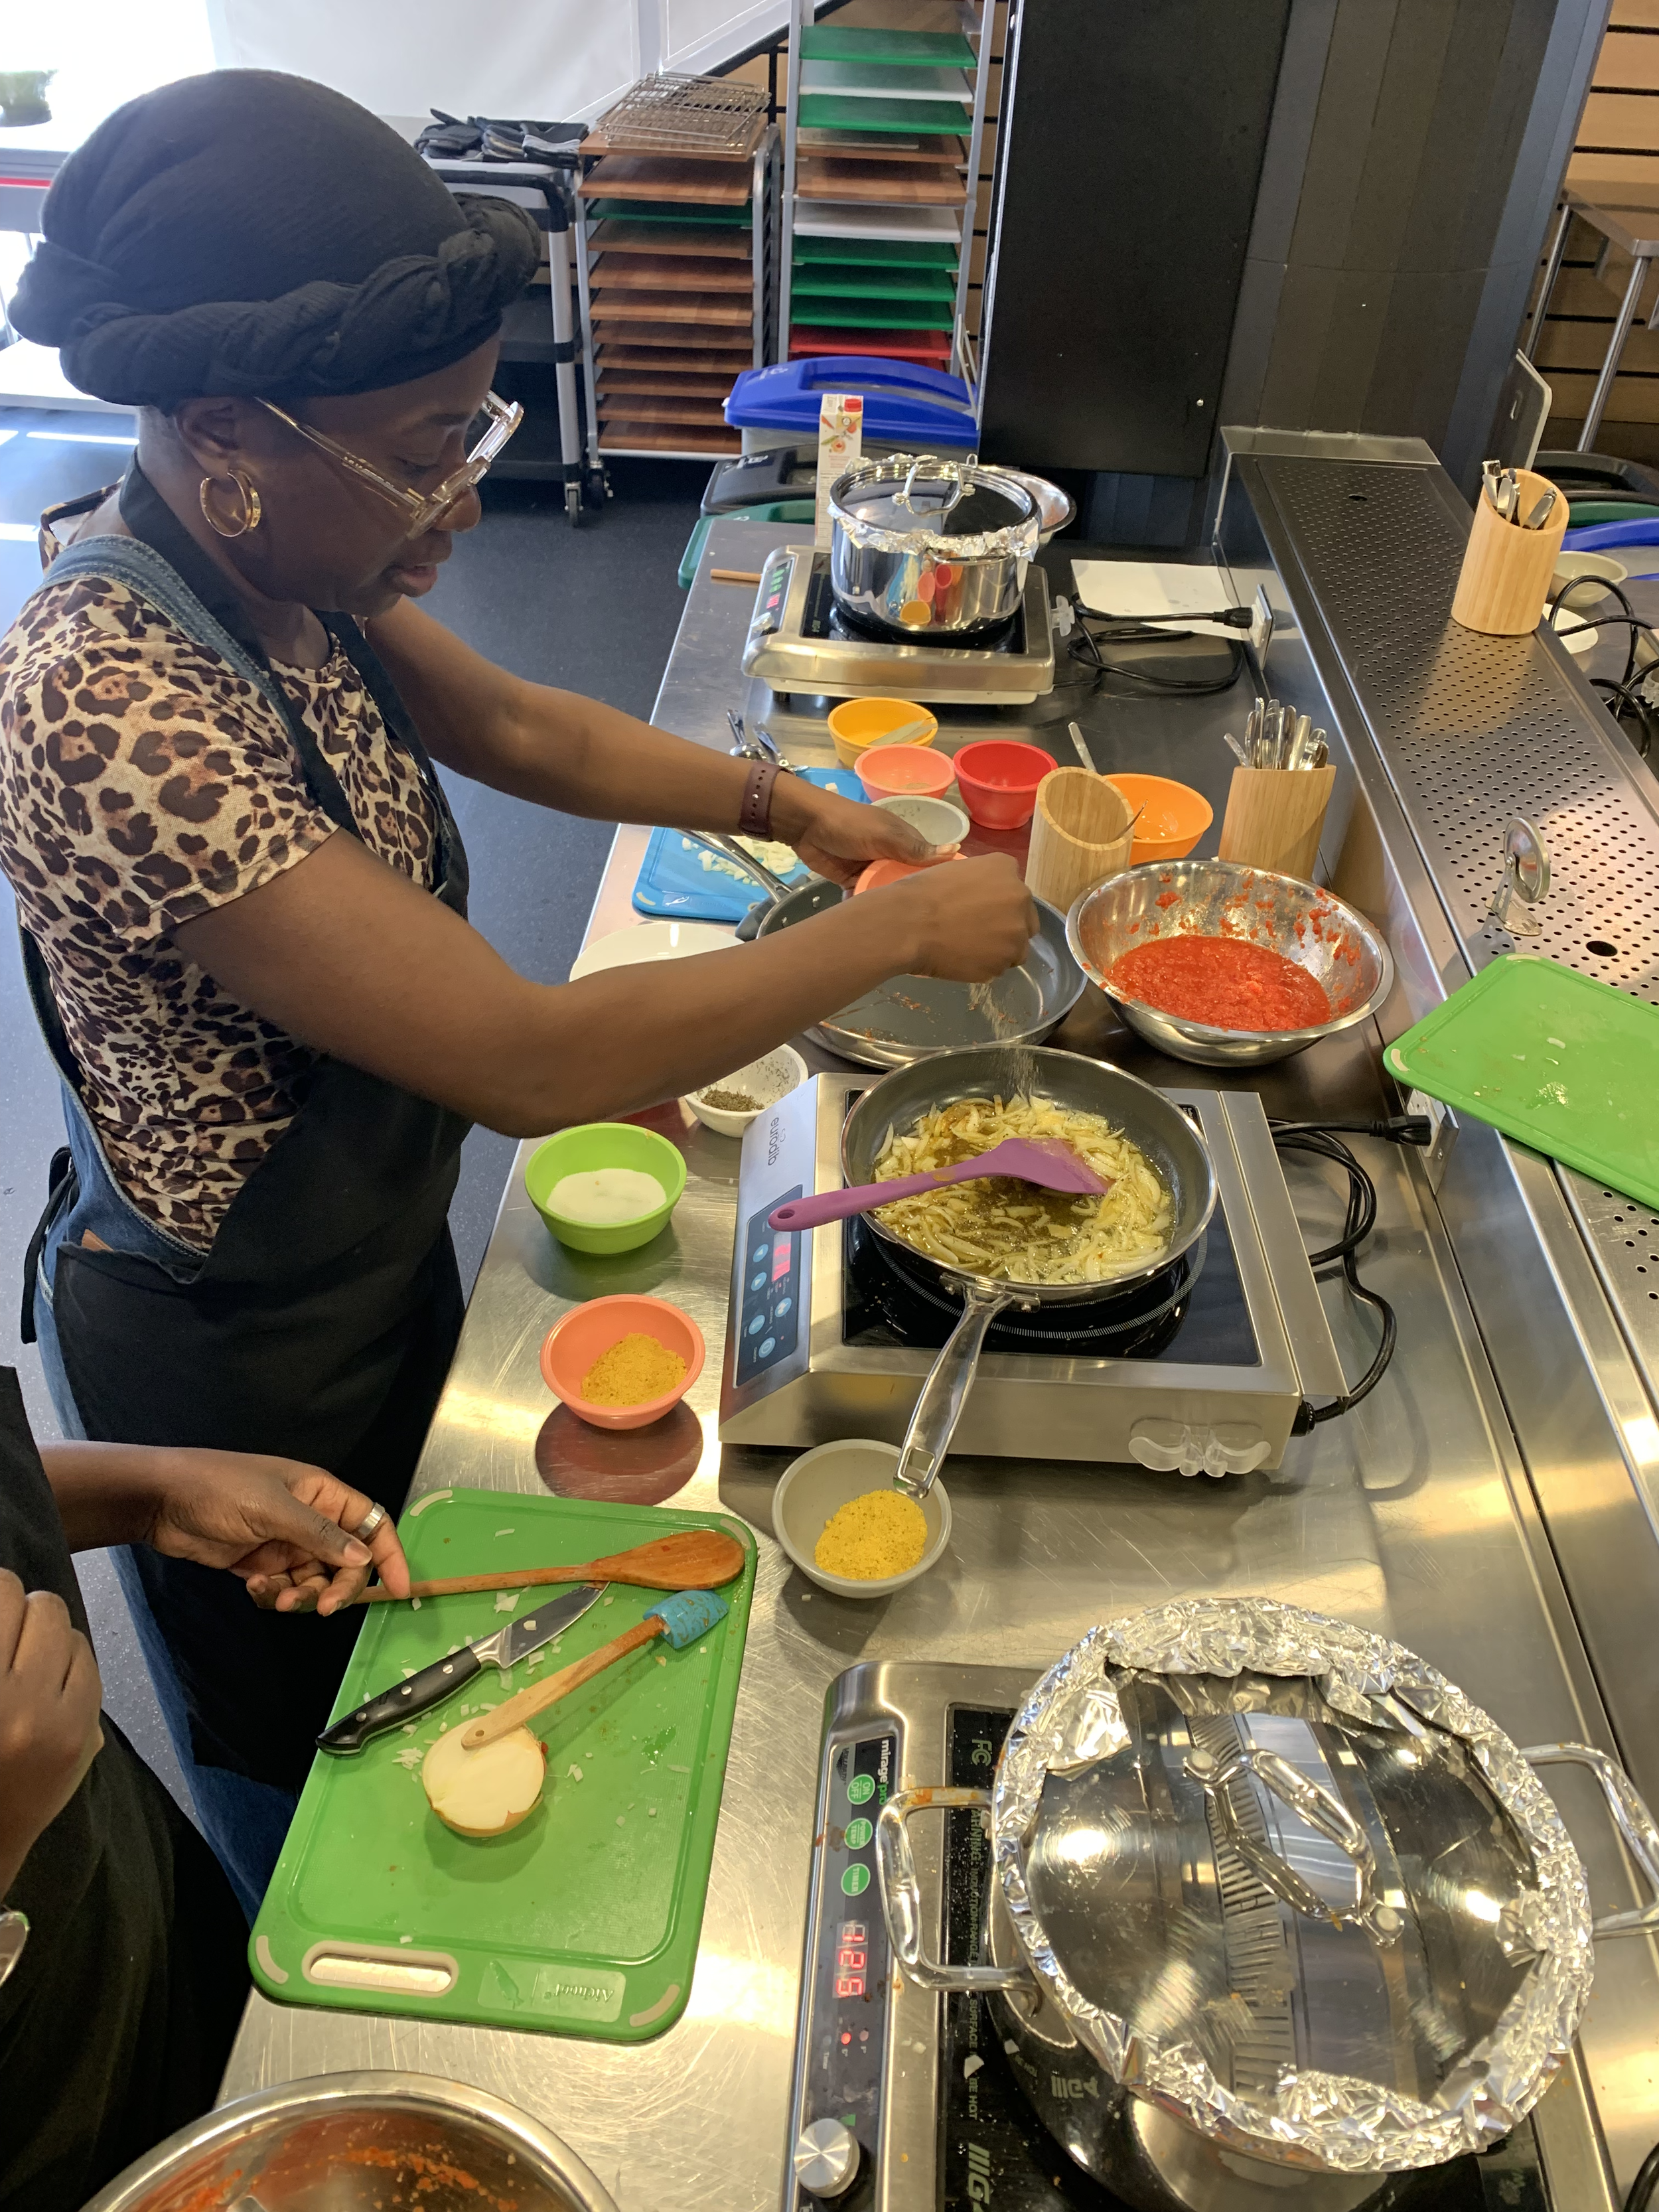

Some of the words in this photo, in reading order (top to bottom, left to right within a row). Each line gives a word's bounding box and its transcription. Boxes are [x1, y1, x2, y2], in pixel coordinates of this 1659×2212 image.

[767, 1118, 780, 1166] eurodib
[850, 1782, 859, 1799] OFF
[862, 1782, 871, 1795] ON
[970, 1808, 982, 1865] ARNING:
[851, 1867, 860, 1893] TIMER
[836, 1933, 865, 1997] 125
[969, 1999, 978, 2049] SURFACE
[969, 2078, 977, 2093] BE
[969, 2095, 977, 2120] HOT
